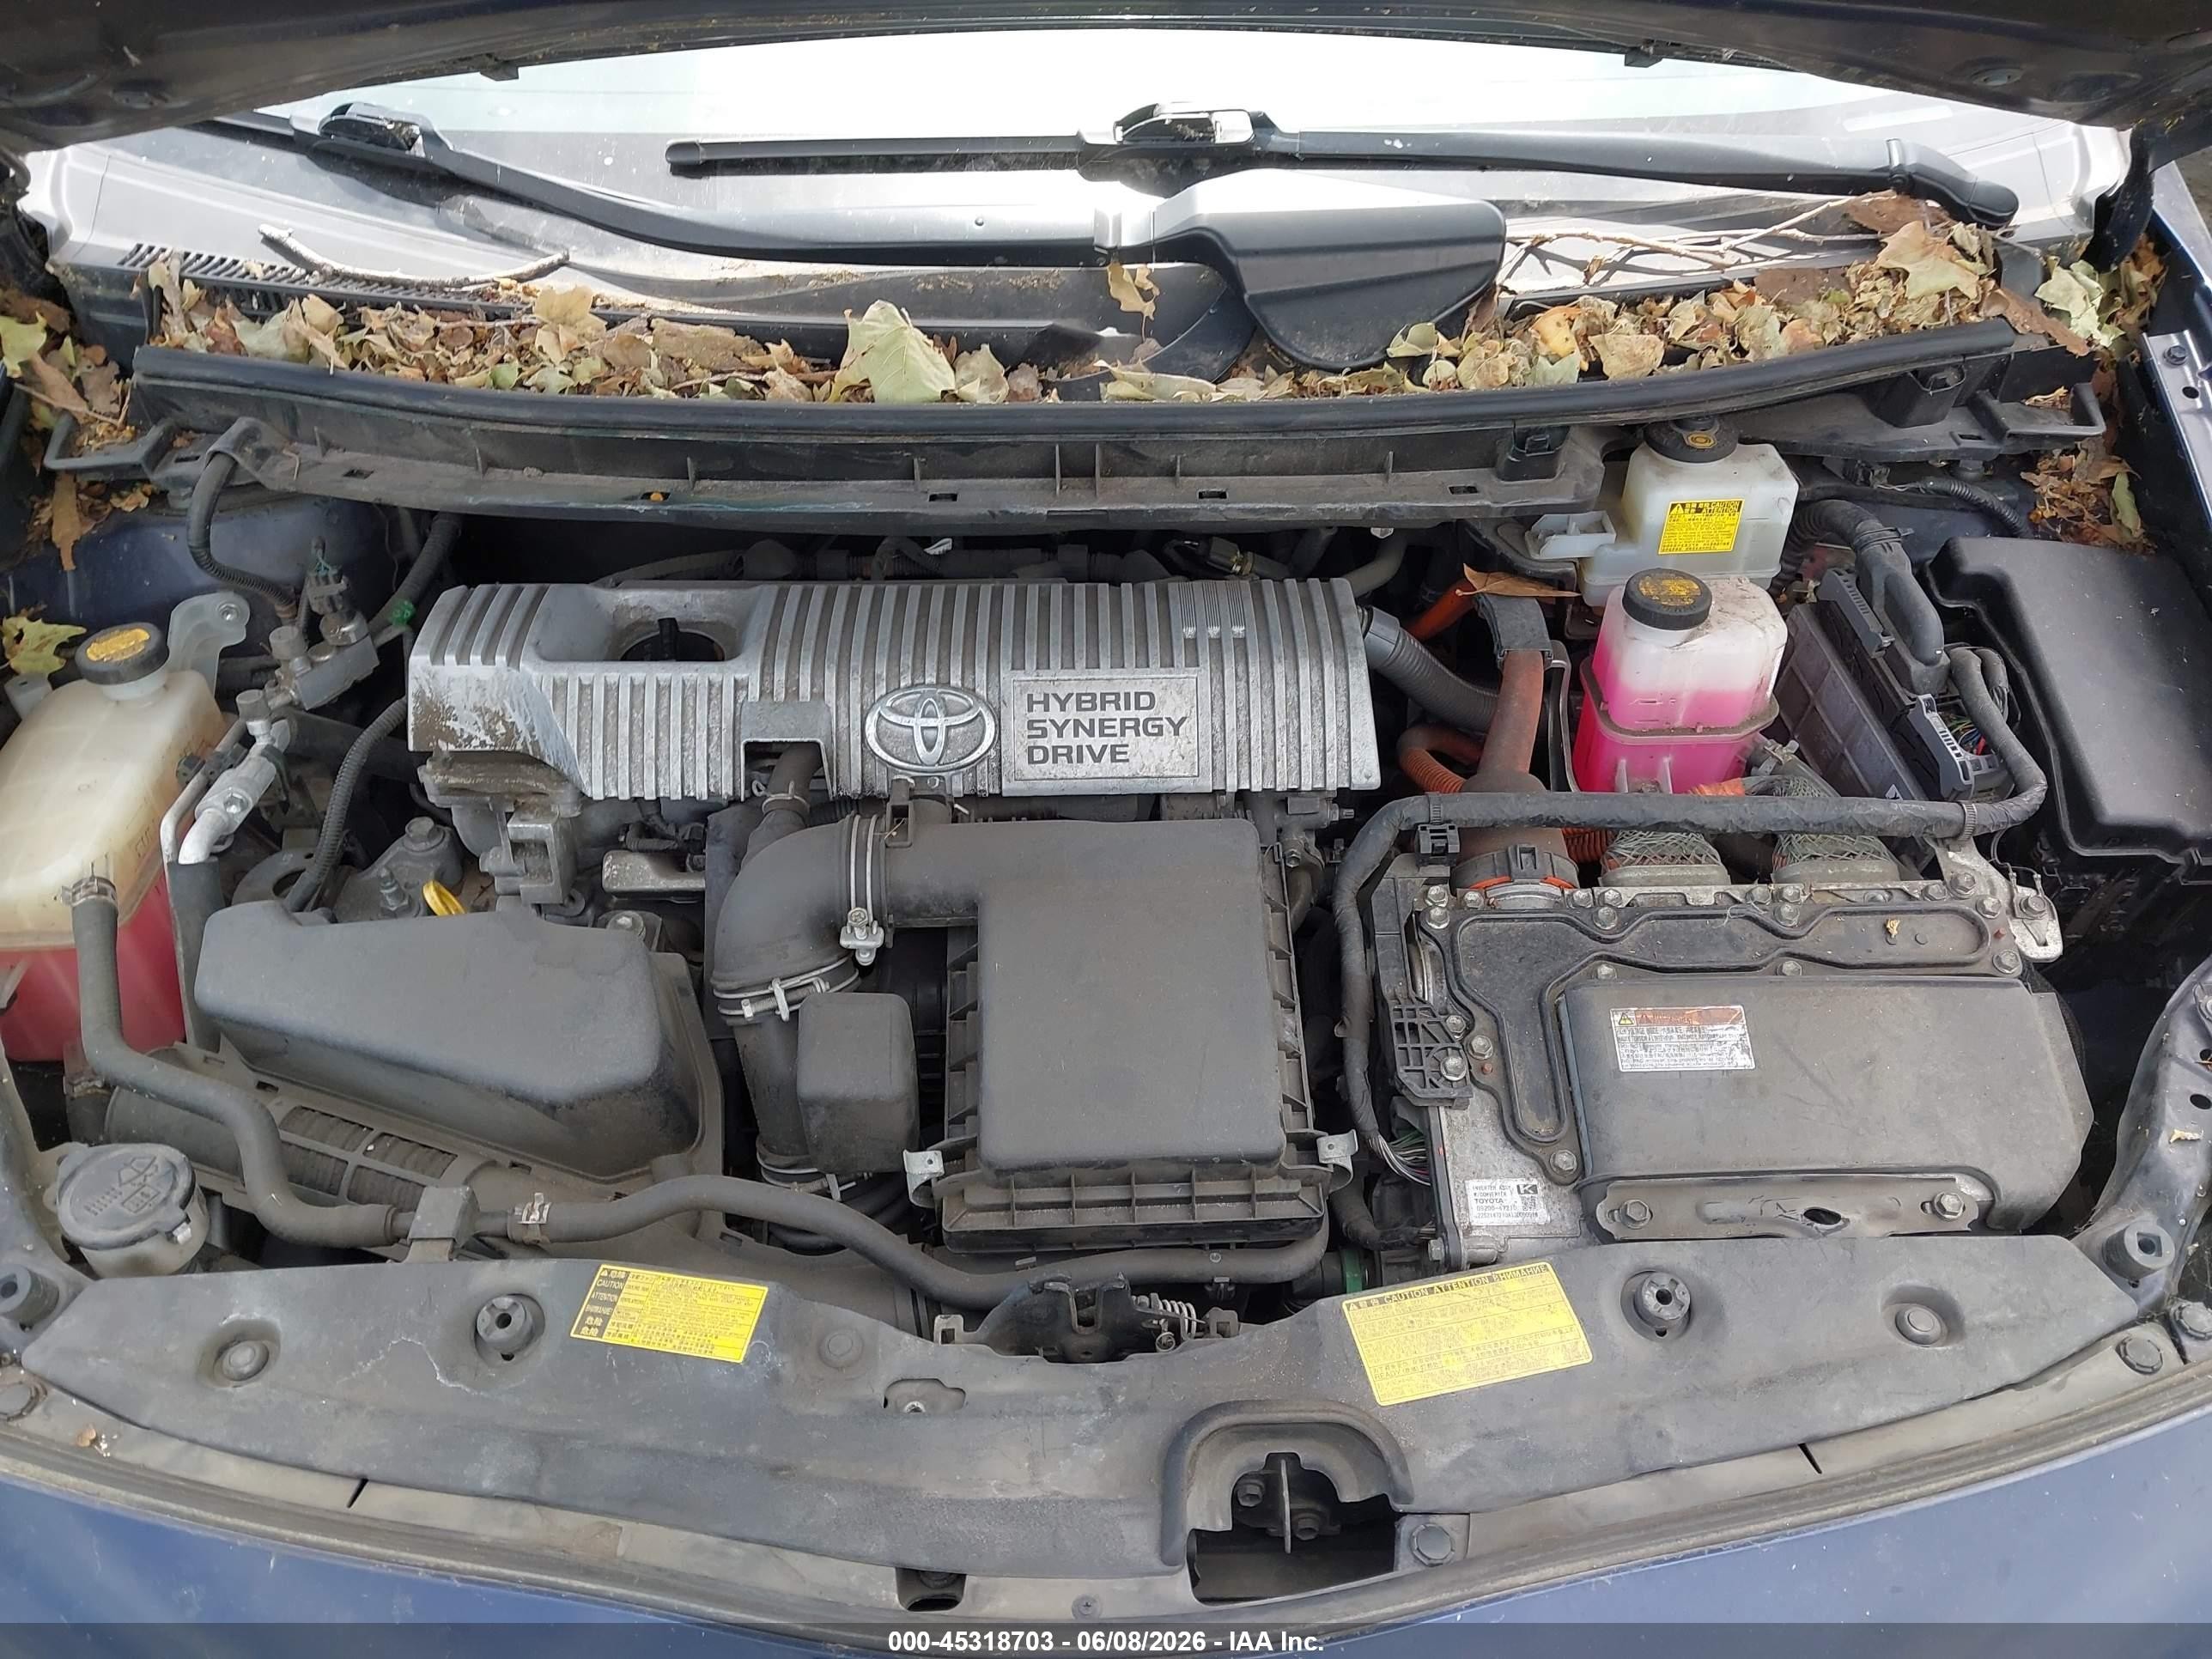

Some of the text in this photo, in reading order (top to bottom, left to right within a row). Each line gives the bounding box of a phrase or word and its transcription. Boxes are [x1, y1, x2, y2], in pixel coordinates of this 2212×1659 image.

[1027, 691, 1156, 713] HYBRID
[1027, 716, 1188, 739] SYNERGY
[1027, 744, 1130, 764] DRIVE
[596, 1279, 625, 1290] CAUTION
[1384, 1288, 1429, 1303] CAUTION
[1433, 1277, 1489, 1293] ATTENTION
[1492, 1264, 1547, 1281] ВНИМАНИЕ
[591, 1291, 619, 1302] ATTENTION
